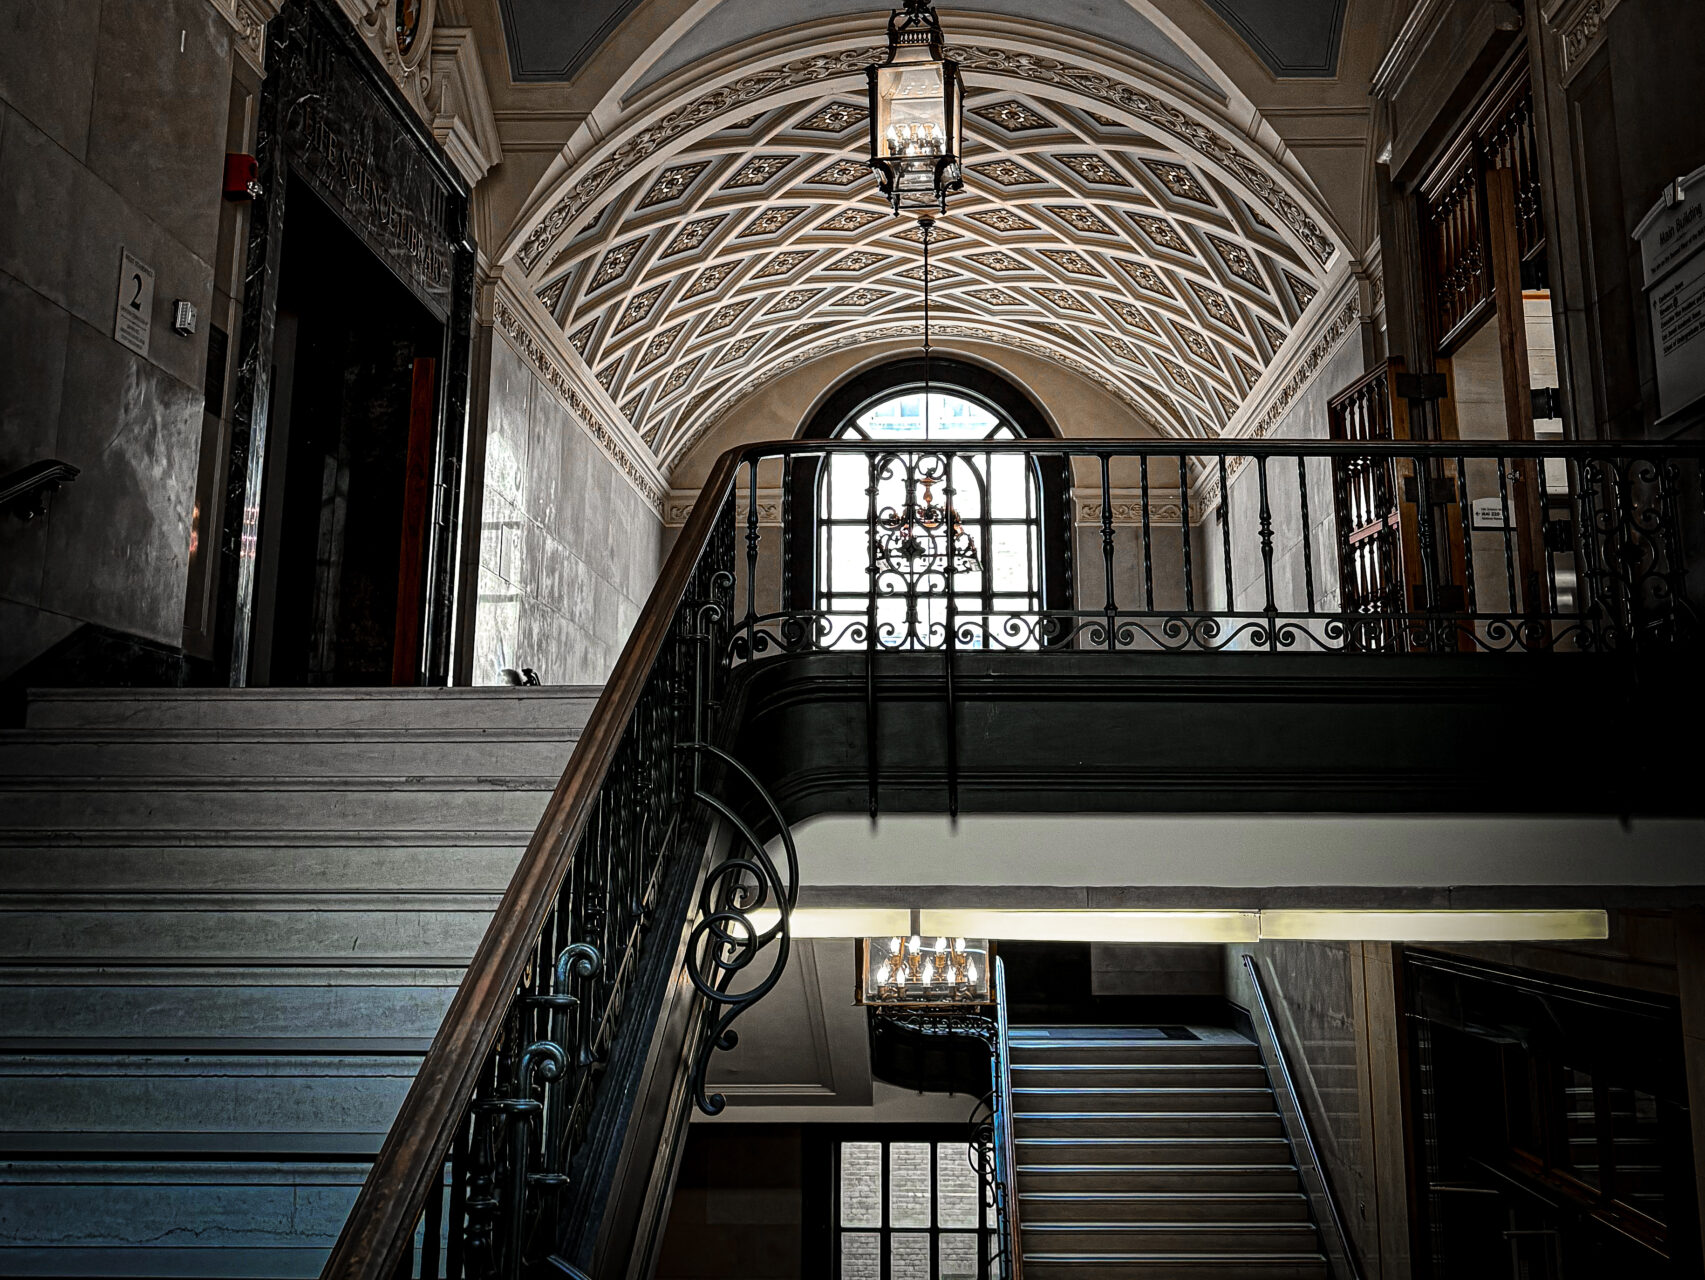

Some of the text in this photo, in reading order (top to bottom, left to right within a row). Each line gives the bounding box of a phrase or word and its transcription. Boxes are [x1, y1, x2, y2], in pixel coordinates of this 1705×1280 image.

[303, 103, 445, 283] LIFE SCIENCE LIBRARY
[1660, 226, 1675, 247] Main
[1676, 203, 1702, 232] Building
[130, 273, 142, 311] 2
